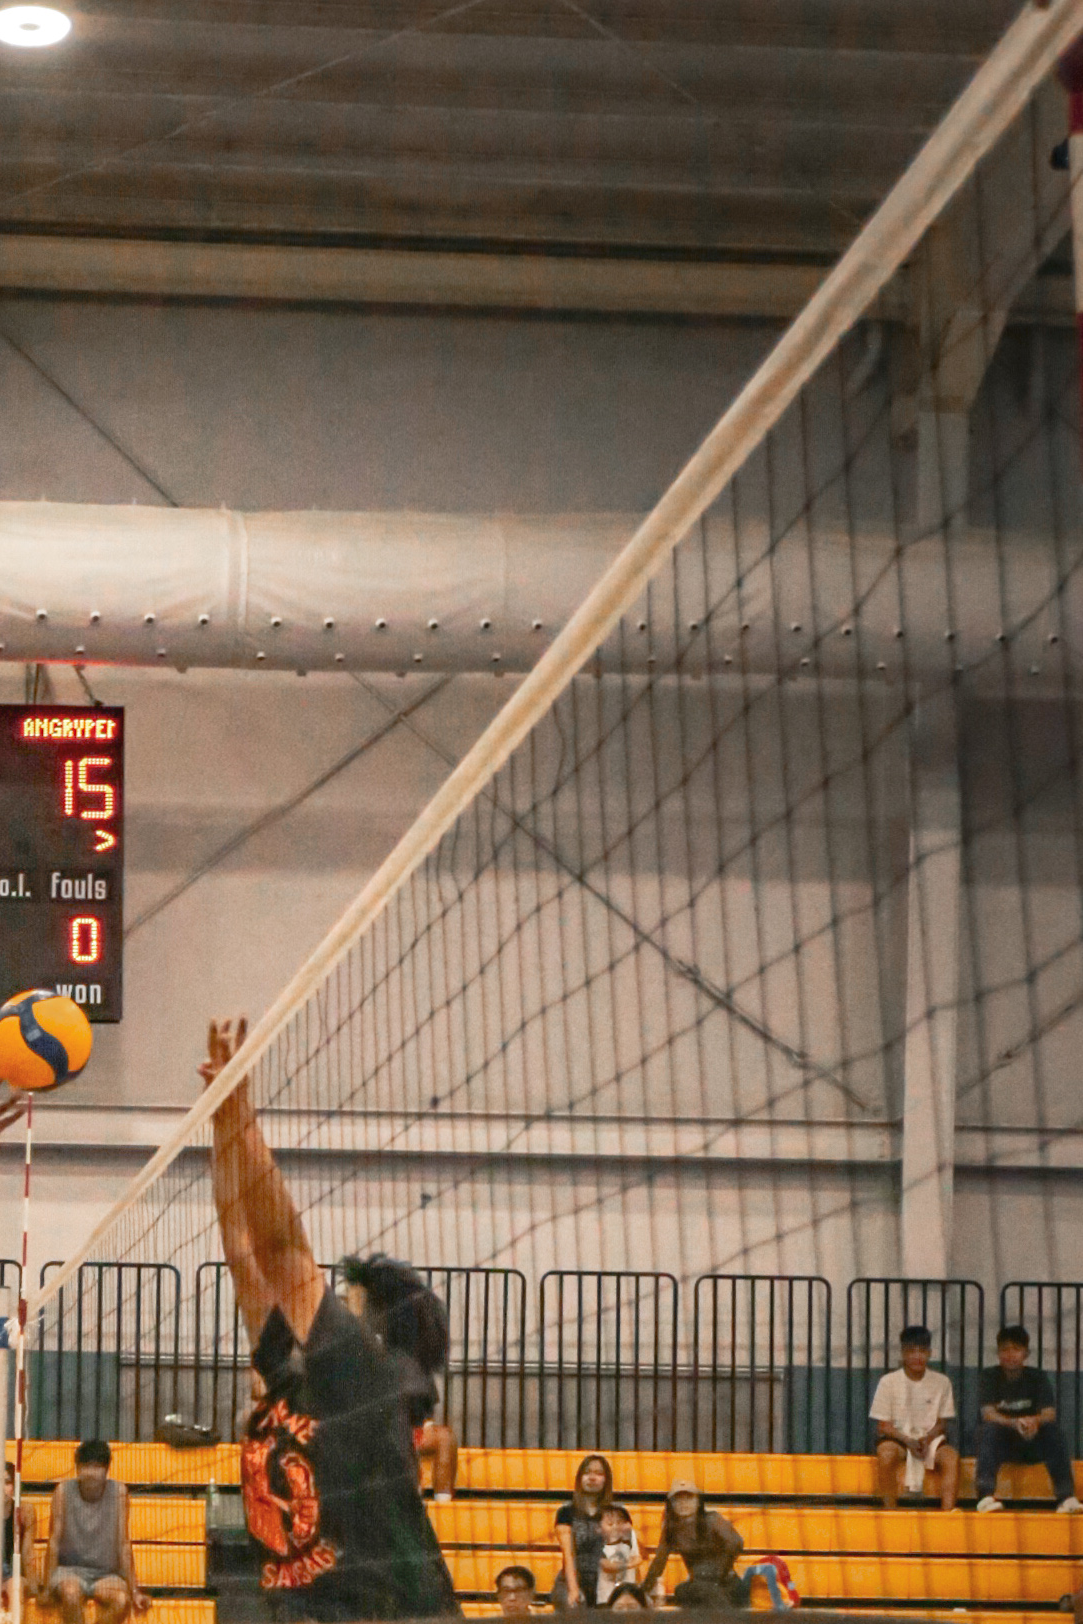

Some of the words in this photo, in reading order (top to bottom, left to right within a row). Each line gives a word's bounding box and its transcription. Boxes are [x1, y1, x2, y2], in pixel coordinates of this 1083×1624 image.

[64, 758, 113, 819] 15
[51, 872, 106, 899] fouls
[72, 917, 98, 962] 0
[56, 984, 102, 1004] won
